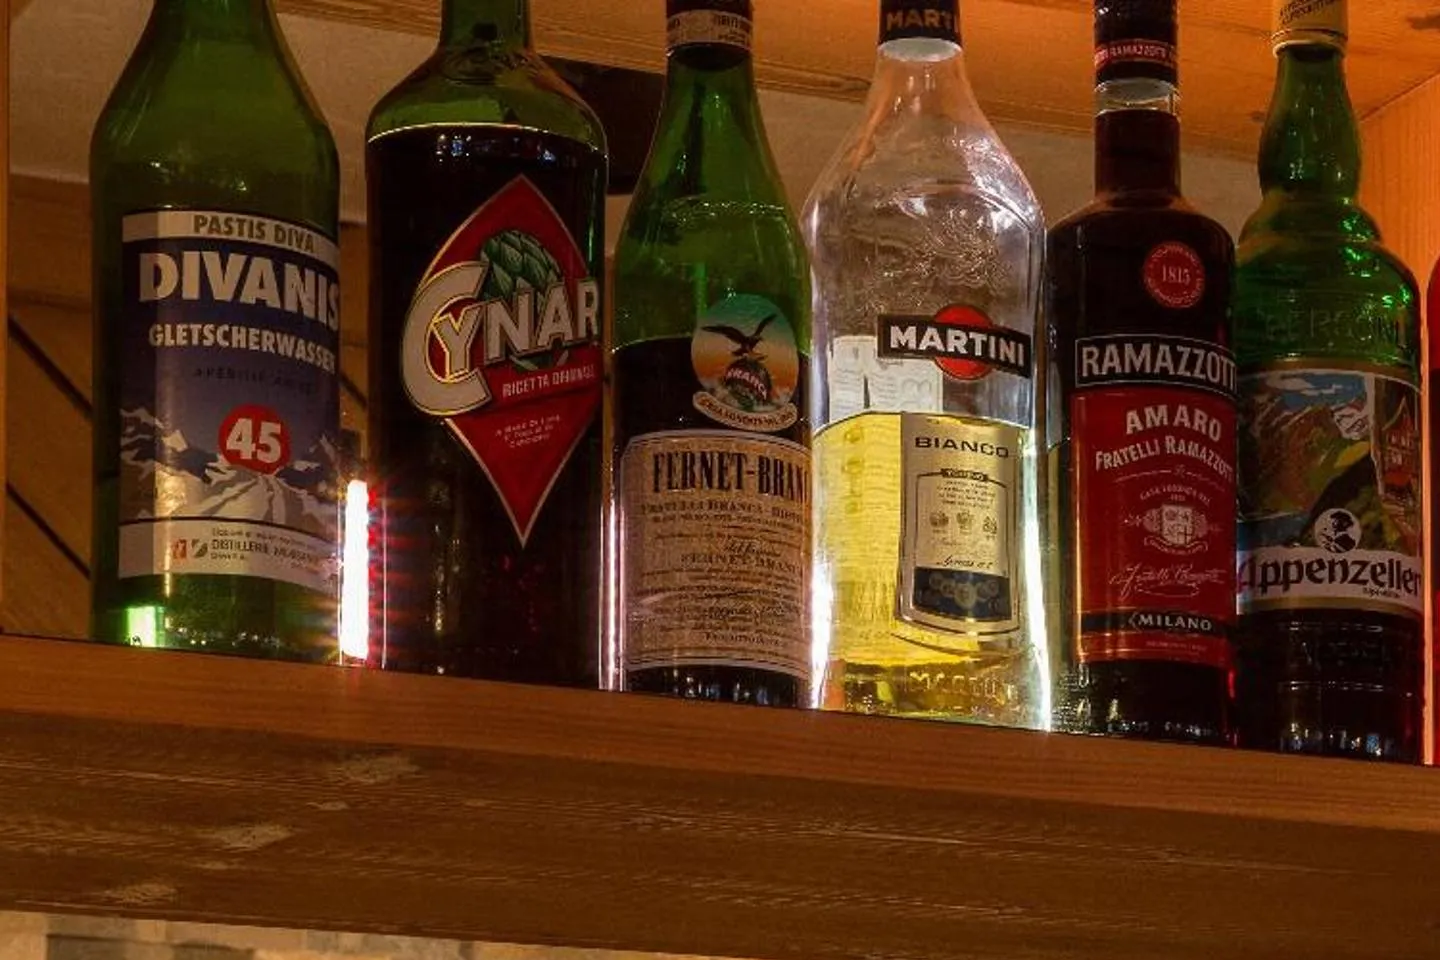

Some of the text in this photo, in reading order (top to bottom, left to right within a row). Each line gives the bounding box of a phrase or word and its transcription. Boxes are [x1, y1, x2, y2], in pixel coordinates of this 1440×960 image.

[193, 214, 315, 254] PASTIS DIVA
[1161, 263, 1191, 284] 1815
[402, 260, 600, 418] CYNAR
[889, 326, 1025, 367] MARTINI
[502, 374, 550, 399] RICETTA
[226, 417, 283, 464] 45
[1126, 404, 1222, 442] AMARO
[915, 436, 1009, 459] BIANCO
[1096, 438, 1161, 471] FRATELLI
[1138, 613, 1212, 631] MILANO
